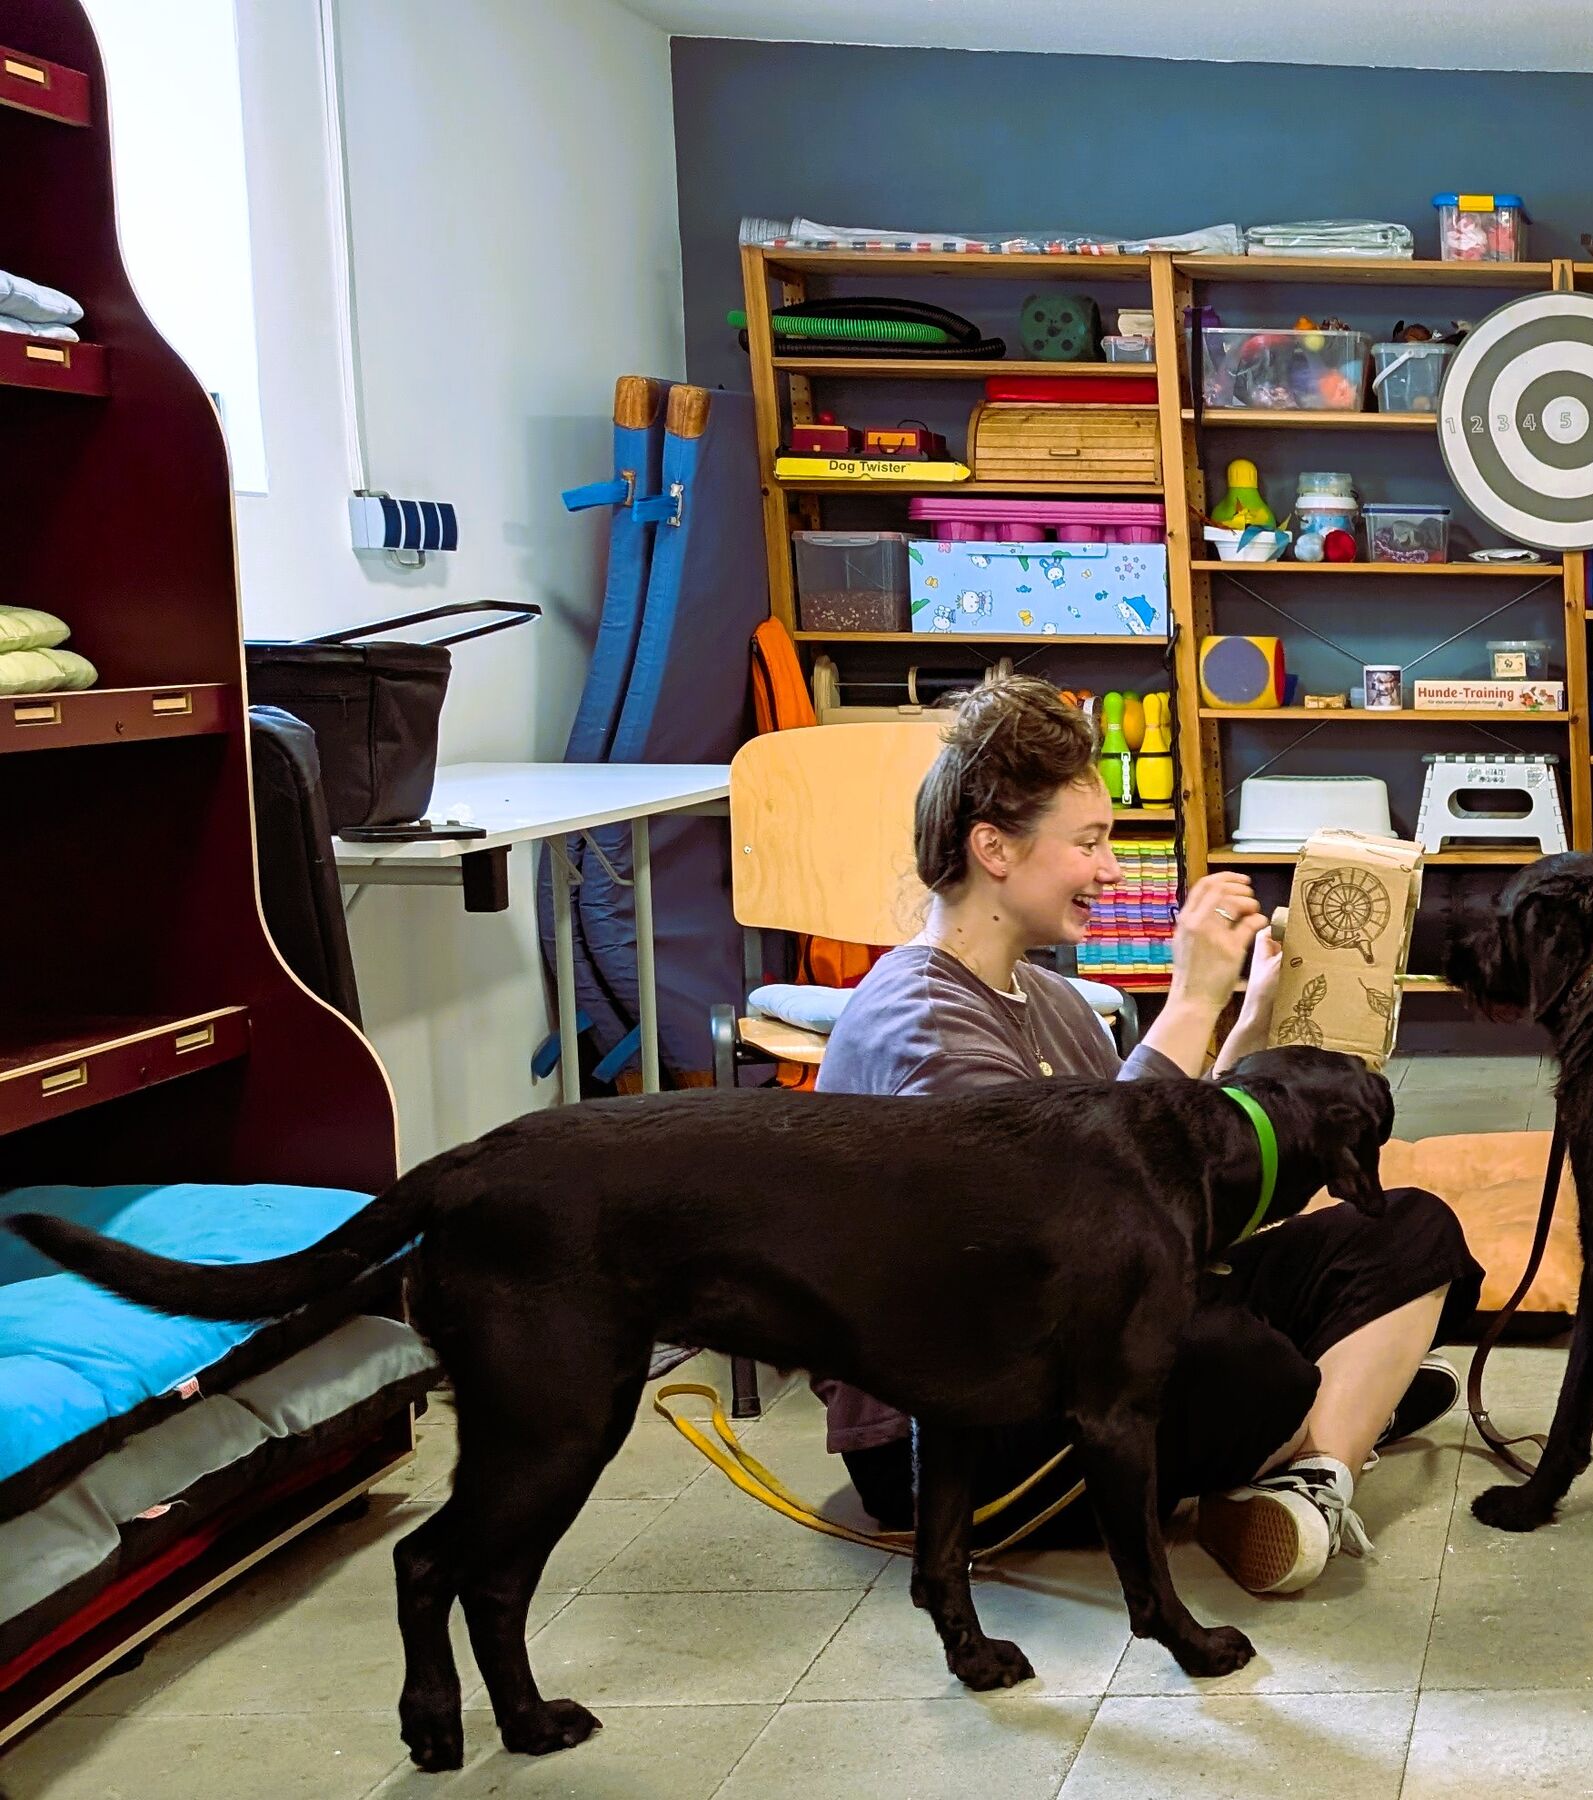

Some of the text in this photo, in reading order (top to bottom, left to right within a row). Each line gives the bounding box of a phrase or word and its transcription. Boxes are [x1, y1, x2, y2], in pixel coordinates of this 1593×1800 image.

[1445, 417, 1456, 433] 1
[1471, 416, 1484, 432] 2
[1497, 414, 1510, 431] 3
[1523, 413, 1536, 430] 4
[1559, 411, 1572, 428] 5
[829, 460, 906, 473] Dog Twister
[1418, 687, 1514, 702] Hunde-Training
